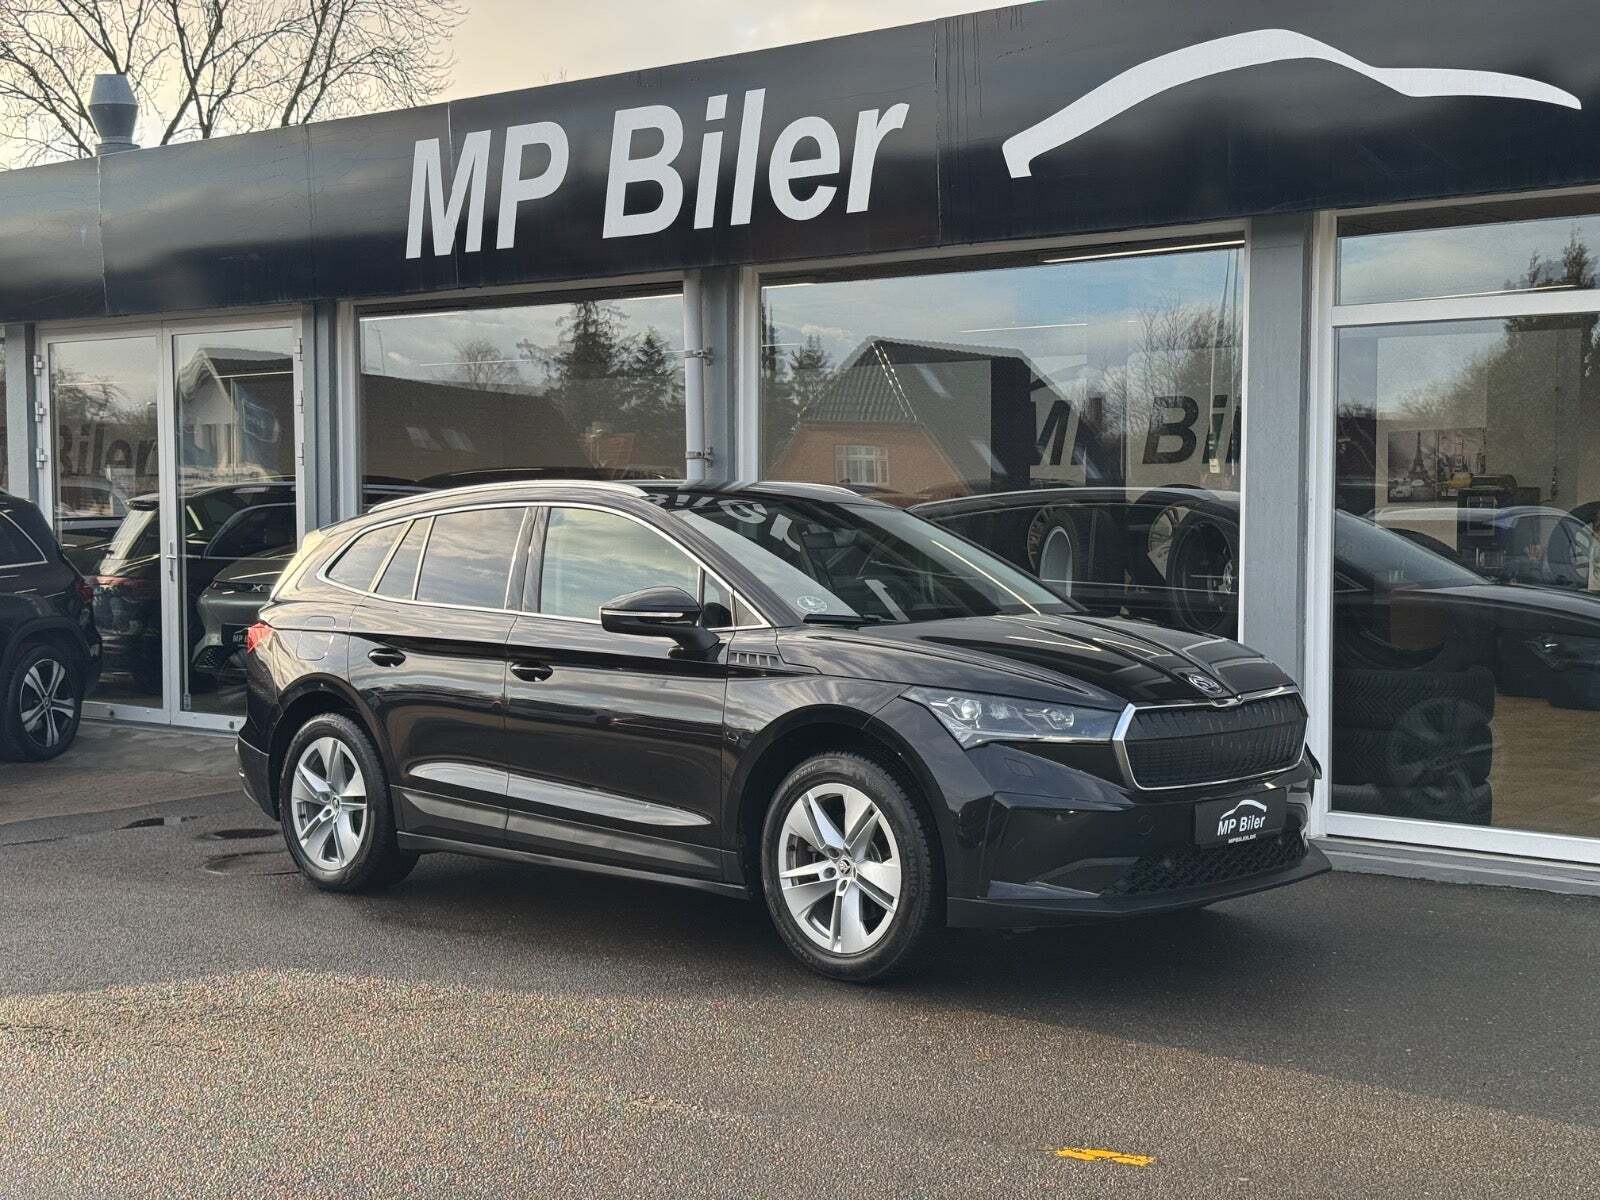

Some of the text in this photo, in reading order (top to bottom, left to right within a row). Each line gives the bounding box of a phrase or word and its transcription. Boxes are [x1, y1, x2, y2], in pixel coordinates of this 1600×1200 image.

[406, 88, 910, 259] MP Biler
[1217, 815, 1266, 836] MP Biler
